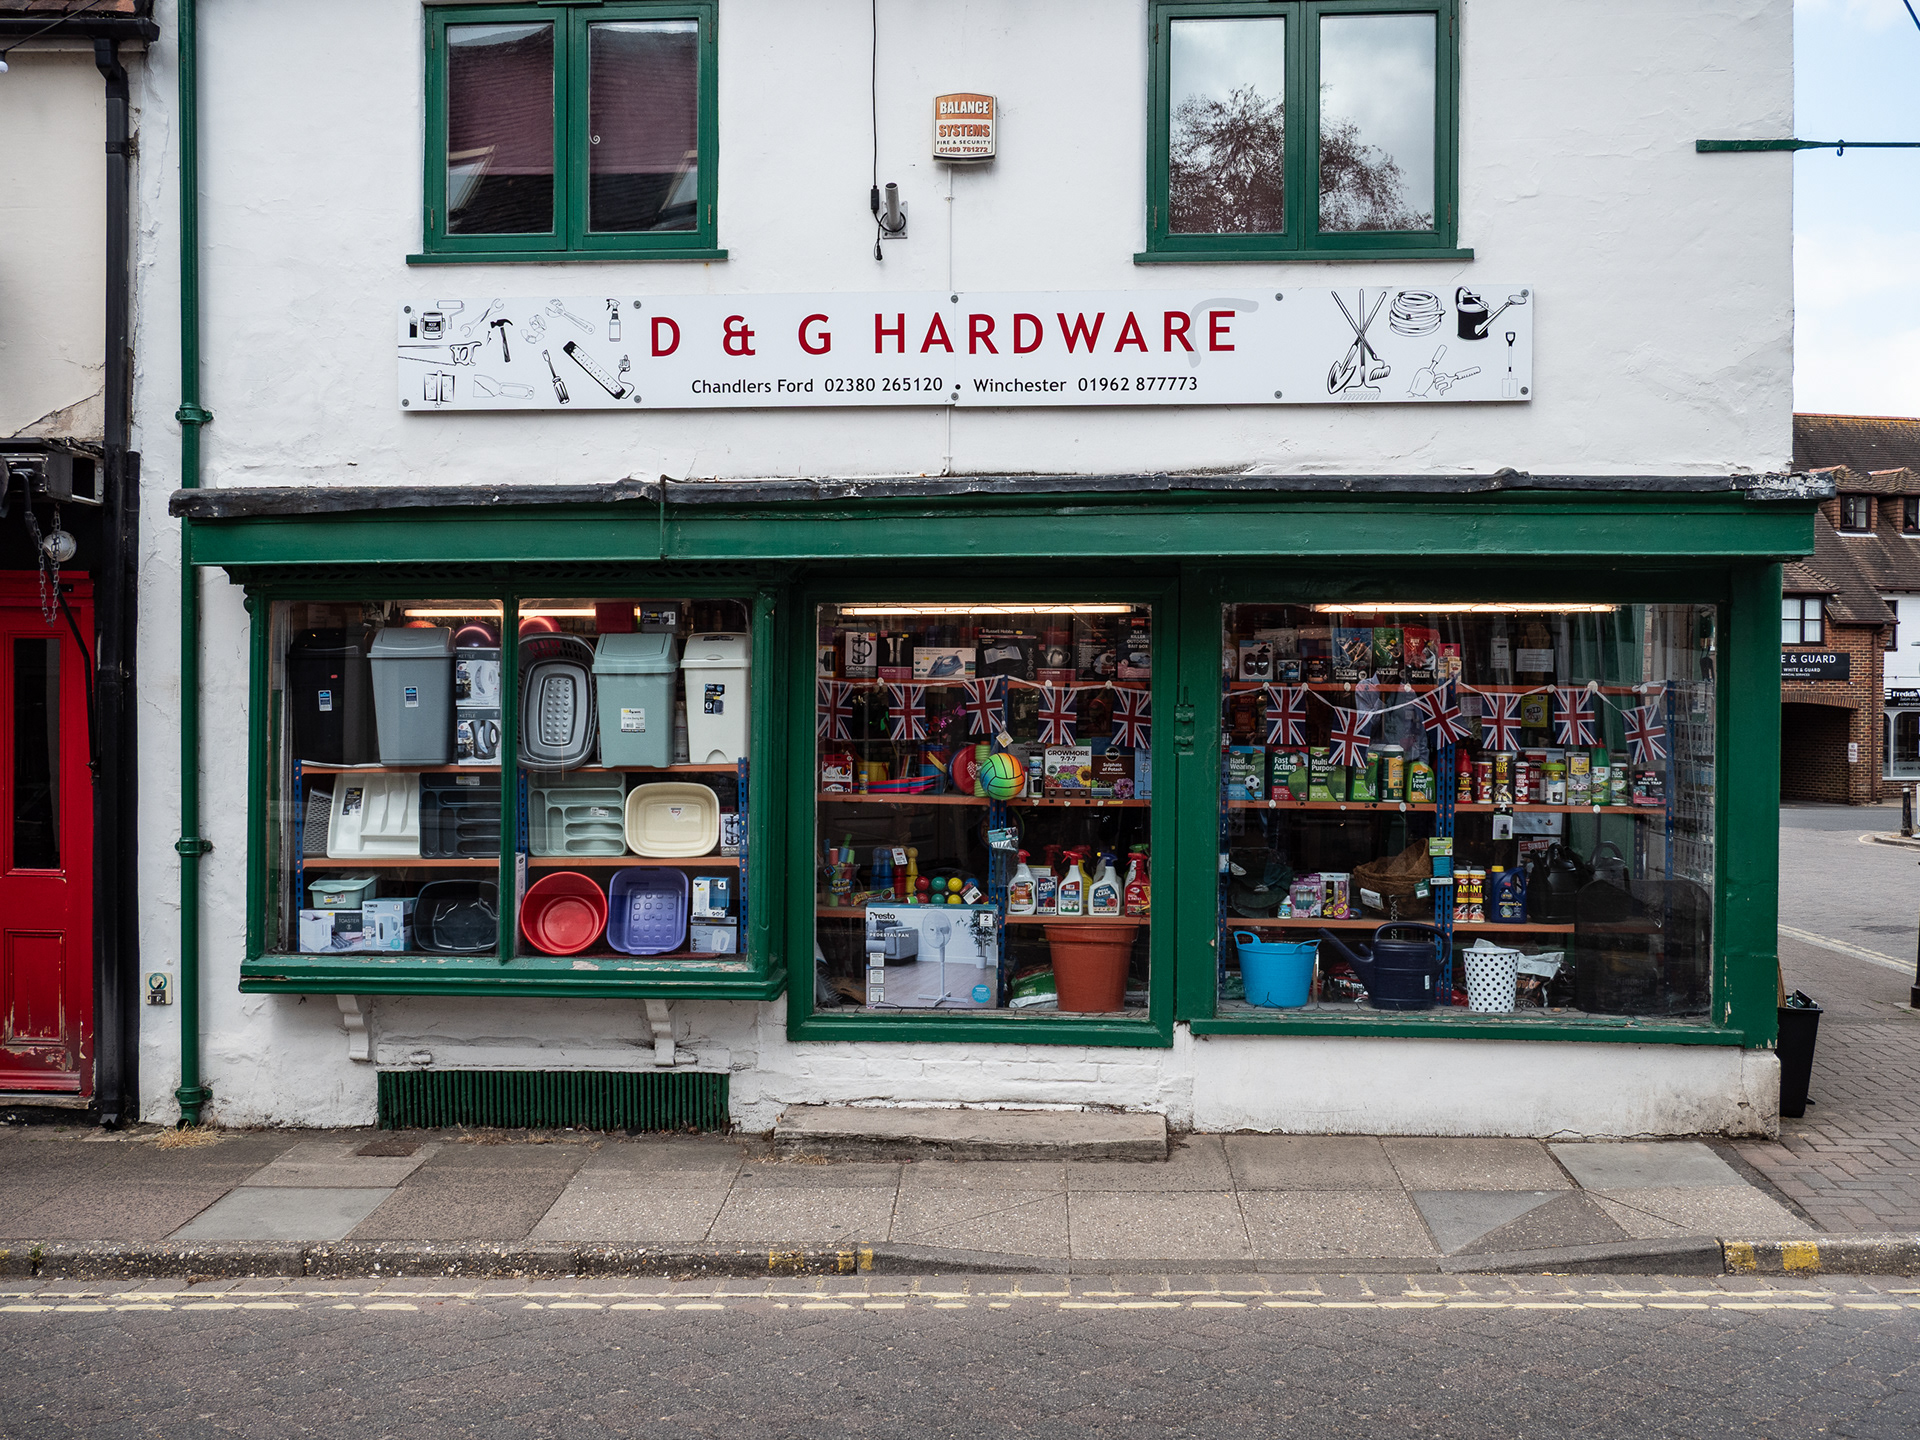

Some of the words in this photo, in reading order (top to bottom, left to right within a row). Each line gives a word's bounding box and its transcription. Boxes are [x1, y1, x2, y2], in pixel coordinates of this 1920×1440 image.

[940, 101, 989, 114] BALANCE
[939, 124, 990, 137] SYSTEMS
[650, 316, 681, 357] D
[722, 314, 756, 356] &
[798, 313, 832, 355] G
[874, 310, 1236, 354] HARDWARE
[691, 379, 772, 394] Chandlers
[777, 378, 814, 393] Ford
[824, 377, 876, 392] 02380
[882, 376, 943, 391] 265120
[973, 377, 1067, 392] Winchester
[1078, 377, 1130, 391] 01962
[1136, 376, 1198, 391] 877773
[1790, 654, 1797, 663] &
[1800, 654, 1836, 664] GUARD
[1230, 764, 1256, 772] Wearing
[1274, 764, 1296, 772] Acting
[1311, 765, 1336, 773] Purpose
[1527, 840, 1548, 850] SUNDAY
[1470, 885, 1483, 893] ANT
[869, 912, 896, 920] Presto
